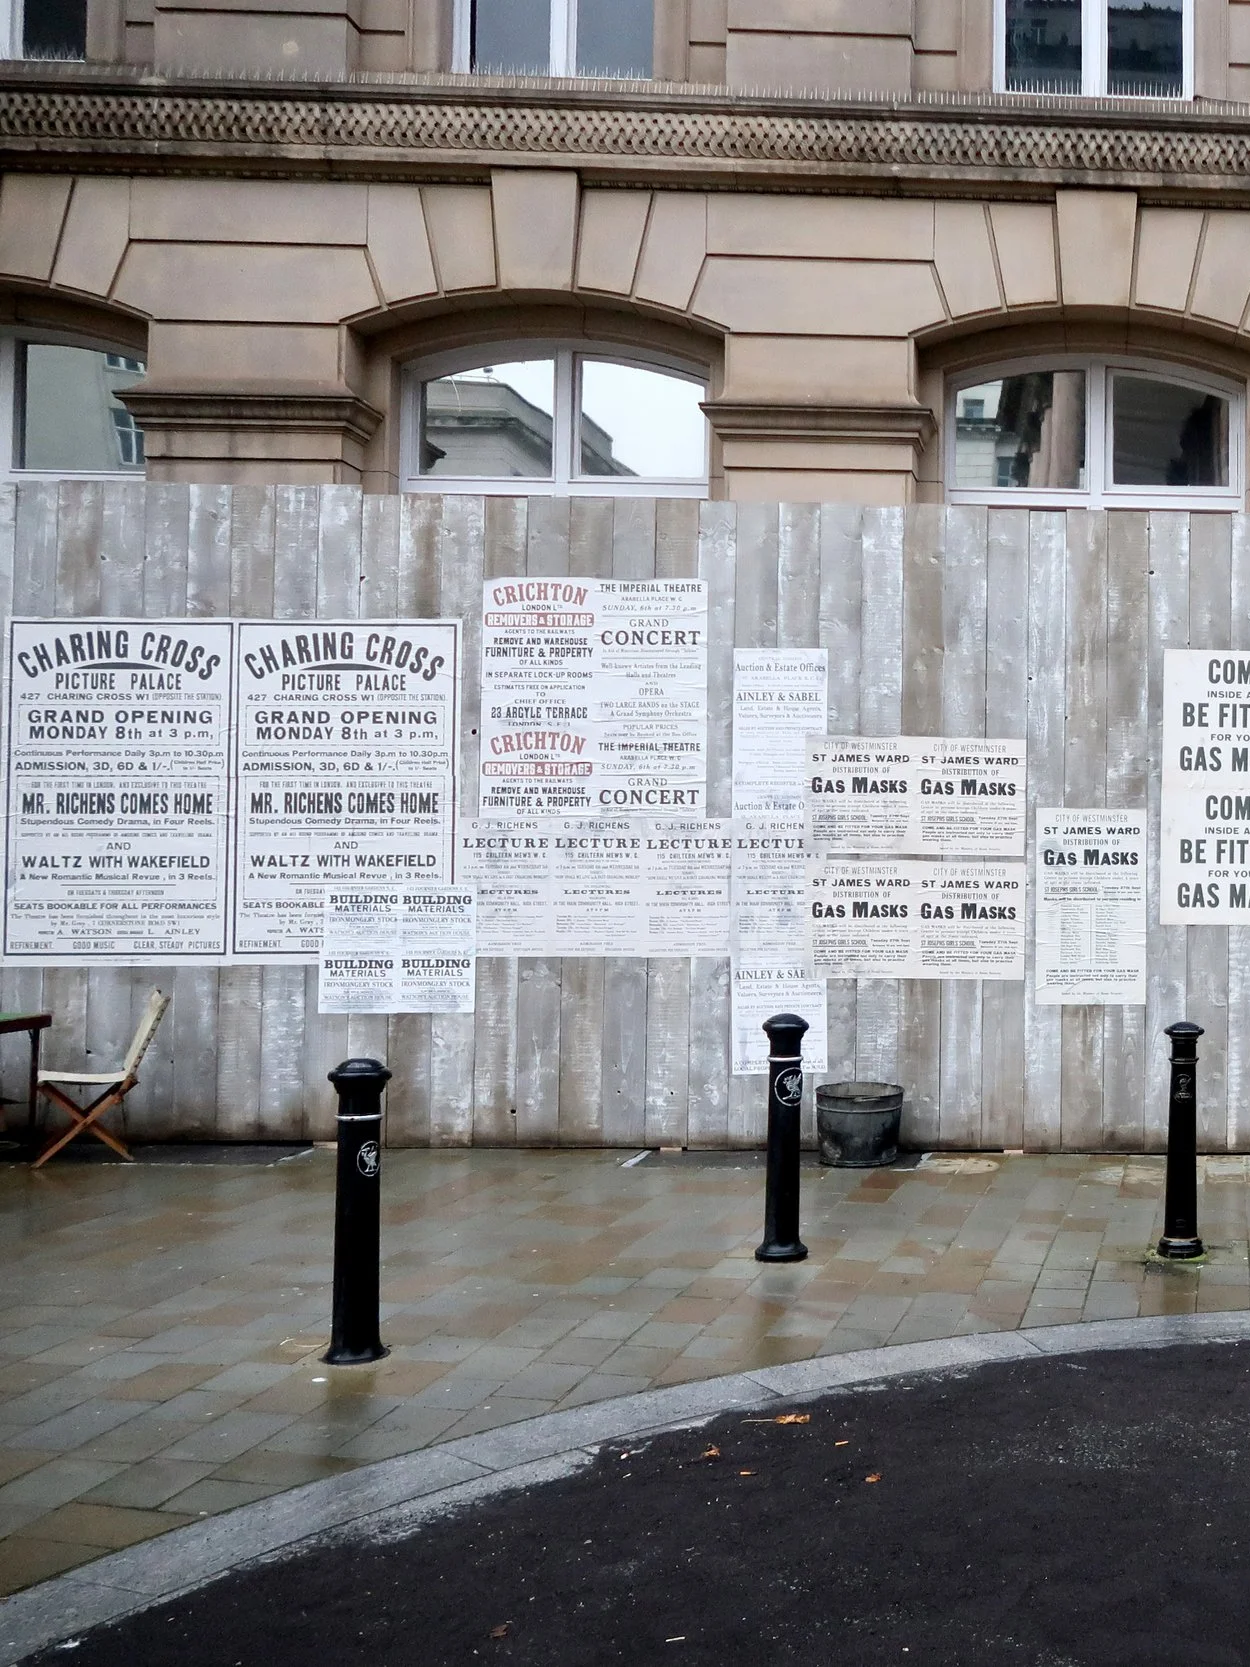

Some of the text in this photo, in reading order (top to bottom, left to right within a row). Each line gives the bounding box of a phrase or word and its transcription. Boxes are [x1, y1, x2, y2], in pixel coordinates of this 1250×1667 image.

[492, 582, 589, 606] CRICHTON
[600, 584, 702, 593] THE IMPERIAL THEATRE
[487, 614, 593, 626] REMOVERS & STORAGE
[629, 619, 669, 627] GRAND
[601, 630, 701, 645] CONCERT
[17, 630, 221, 681] CHARING CROSS
[244, 631, 445, 682] CHARING CROSS
[485, 647, 535, 657] FURNITURE
[538, 647, 546, 657] &
[549, 647, 594, 657] PROPERTY
[735, 663, 826, 673] Auction & Estate Offices
[55, 672, 182, 690] PICTURE PALACE
[282, 674, 407, 691] PICTURE PALACE
[736, 692, 821, 701] AINLEY & SABEL
[1207, 691, 1242, 699] INSIDE
[27, 710, 213, 724] GRAND OPENING
[254, 711, 438, 724] GRAND OPENING
[491, 707, 588, 719] 23 ARGYLE TERRACE
[1182, 702, 1209, 727] BE
[29, 726, 214, 741] MONDAY 8th at 3 p.m,
[256, 726, 439, 741] MONDAY 8th at 3 p.m,
[1210, 733, 1232, 742] FOR
[490, 731, 586, 755] CRICHTON
[812, 754, 910, 763] ST JAMES WARD
[1179, 746, 1222, 772] GAS
[628, 778, 668, 786] GRAND
[599, 790, 699, 804] CONCERT
[22, 793, 213, 815] MR. RICHENS COMES HOME
[250, 792, 439, 814] MR. RICHENS COMES HOME
[20, 818, 75, 826] Stupendous
[77, 818, 114, 826] Comedy
[1043, 827, 1141, 835] ST JAMES WARD
[1204, 826, 1239, 835] INSIDE
[106, 842, 131, 850] AND
[334, 841, 359, 849] AND
[463, 838, 549, 849] LECTURE
[555, 838, 641, 849] LECTURE
[646, 839, 732, 850] LECTURE
[1180, 838, 1207, 864] BE
[22, 856, 210, 868] WALTZ WITH WAKEFIELD
[250, 855, 437, 867] WALTZ WITH WAKEFIELD
[1208, 870, 1230, 878] FOR
[329, 894, 398, 904] BUILDING
[402, 895, 472, 905] BUILDING
[1177, 883, 1220, 908] GAS
[13, 902, 217, 910] SEATS BOOKABLE FOR ALL PERFORMANCES
[408, 905, 465, 913] MATERIALS
[324, 959, 394, 969] BUILDING
[401, 959, 471, 969] BUILDING
[329, 970, 386, 978] MATERIALS
[407, 969, 463, 977] MATERIALS
